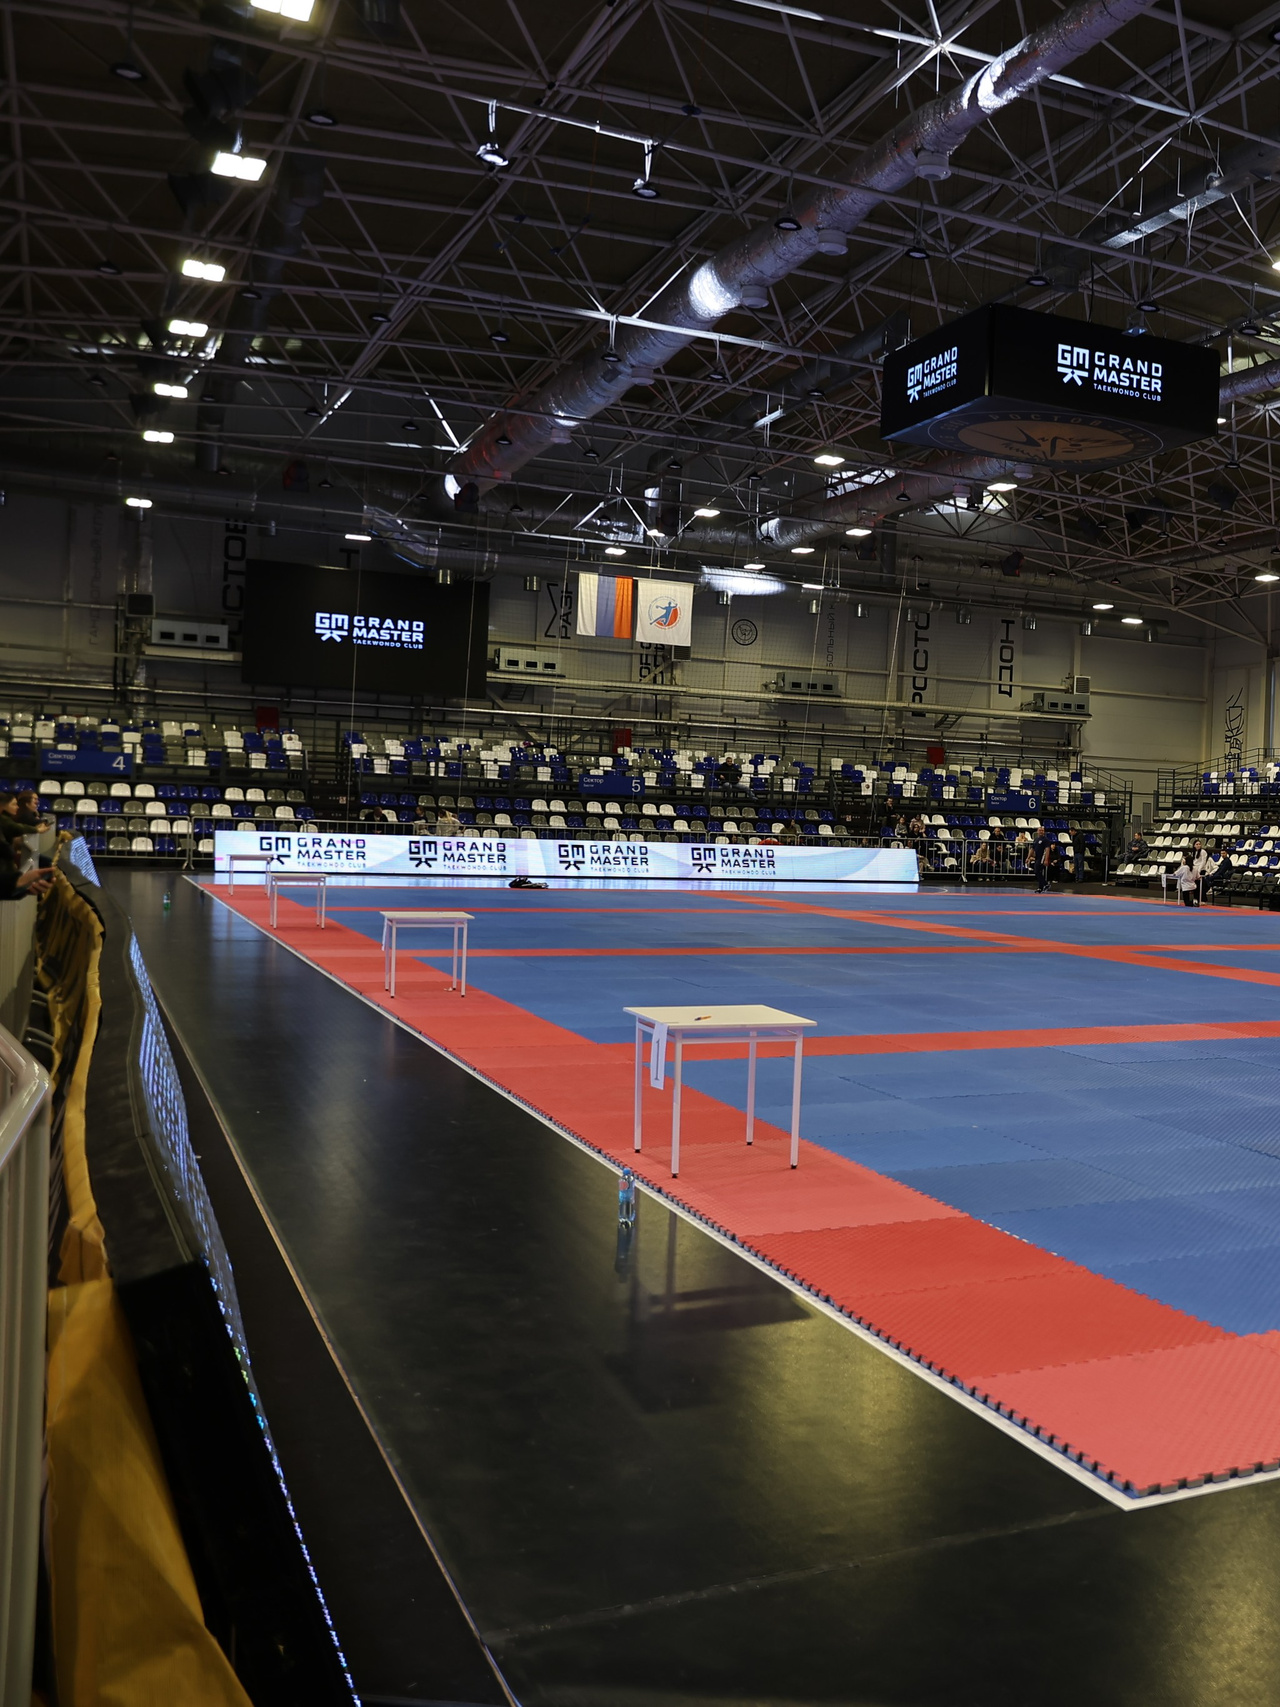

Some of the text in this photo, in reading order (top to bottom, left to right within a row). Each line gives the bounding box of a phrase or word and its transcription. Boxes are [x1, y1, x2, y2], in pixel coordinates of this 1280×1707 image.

[924, 346, 957, 374] GRAND
[1058, 344, 1089, 369] GM
[1095, 351, 1162, 377] GRAND
[923, 362, 957, 389] MASTER
[1094, 367, 1161, 393] MASTER
[1094, 383, 1161, 401] TAEKWONDO CLUB
[315, 612, 348, 630] GM
[353, 616, 424, 631] GRAND
[353, 627, 423, 642] MASTER
[353, 639, 401, 647] TAEKWONDO
[999, 619, 1016, 698] ДОН
[112, 756, 126, 770] 4
[632, 780, 641, 792] 5
[1029, 798, 1036, 809] 6
[260, 836, 291, 851] GM
[297, 838, 366, 849] GRAND
[409, 841, 437, 855] GM
[443, 841, 506, 852] GRAND
[590, 845, 648, 855] GRAND
[297, 850, 366, 860] MASTER
[443, 853, 507, 863] MASTER
[559, 844, 585, 858] GM
[692, 848, 716, 861] GM
[720, 848, 775, 857] GRAND
[590, 856, 649, 866] MASTER
[721, 860, 775, 868] MASTER
[655, 1038, 660, 1080] 1
